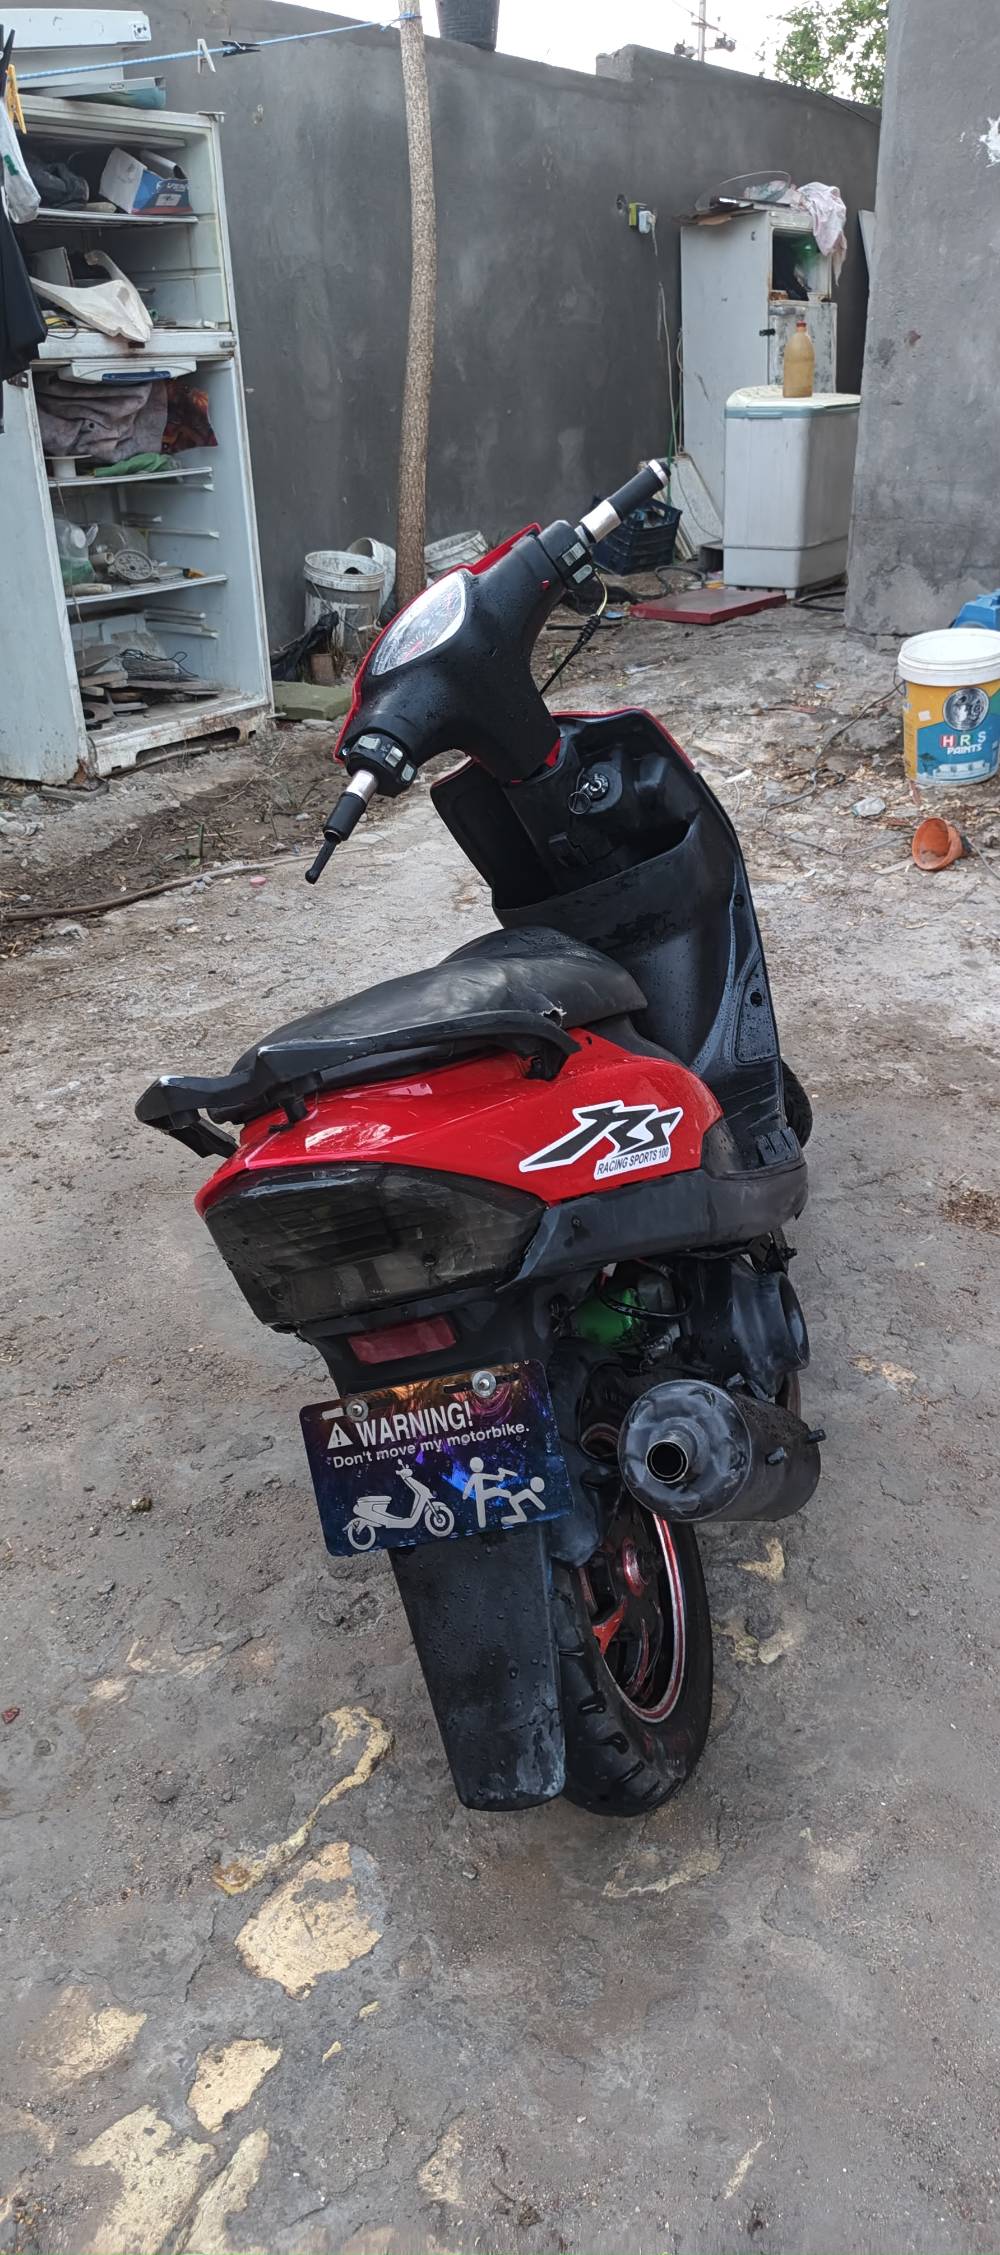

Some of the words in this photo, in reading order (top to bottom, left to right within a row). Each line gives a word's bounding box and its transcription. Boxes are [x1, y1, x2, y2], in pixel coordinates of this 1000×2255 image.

[942, 731, 986, 747] HRS
[946, 743, 982, 755] PAINTS
[597, 1157, 628, 1175] RACING
[629, 1149, 657, 1167] SPORTS
[657, 1145, 669, 1160] 100
[355, 1401, 473, 1448] WARNING!
[333, 1450, 373, 1469] Don't
[376, 1443, 416, 1461] move
[420, 1439, 442, 1453] my
[447, 1422, 530, 1446] motorbike.
